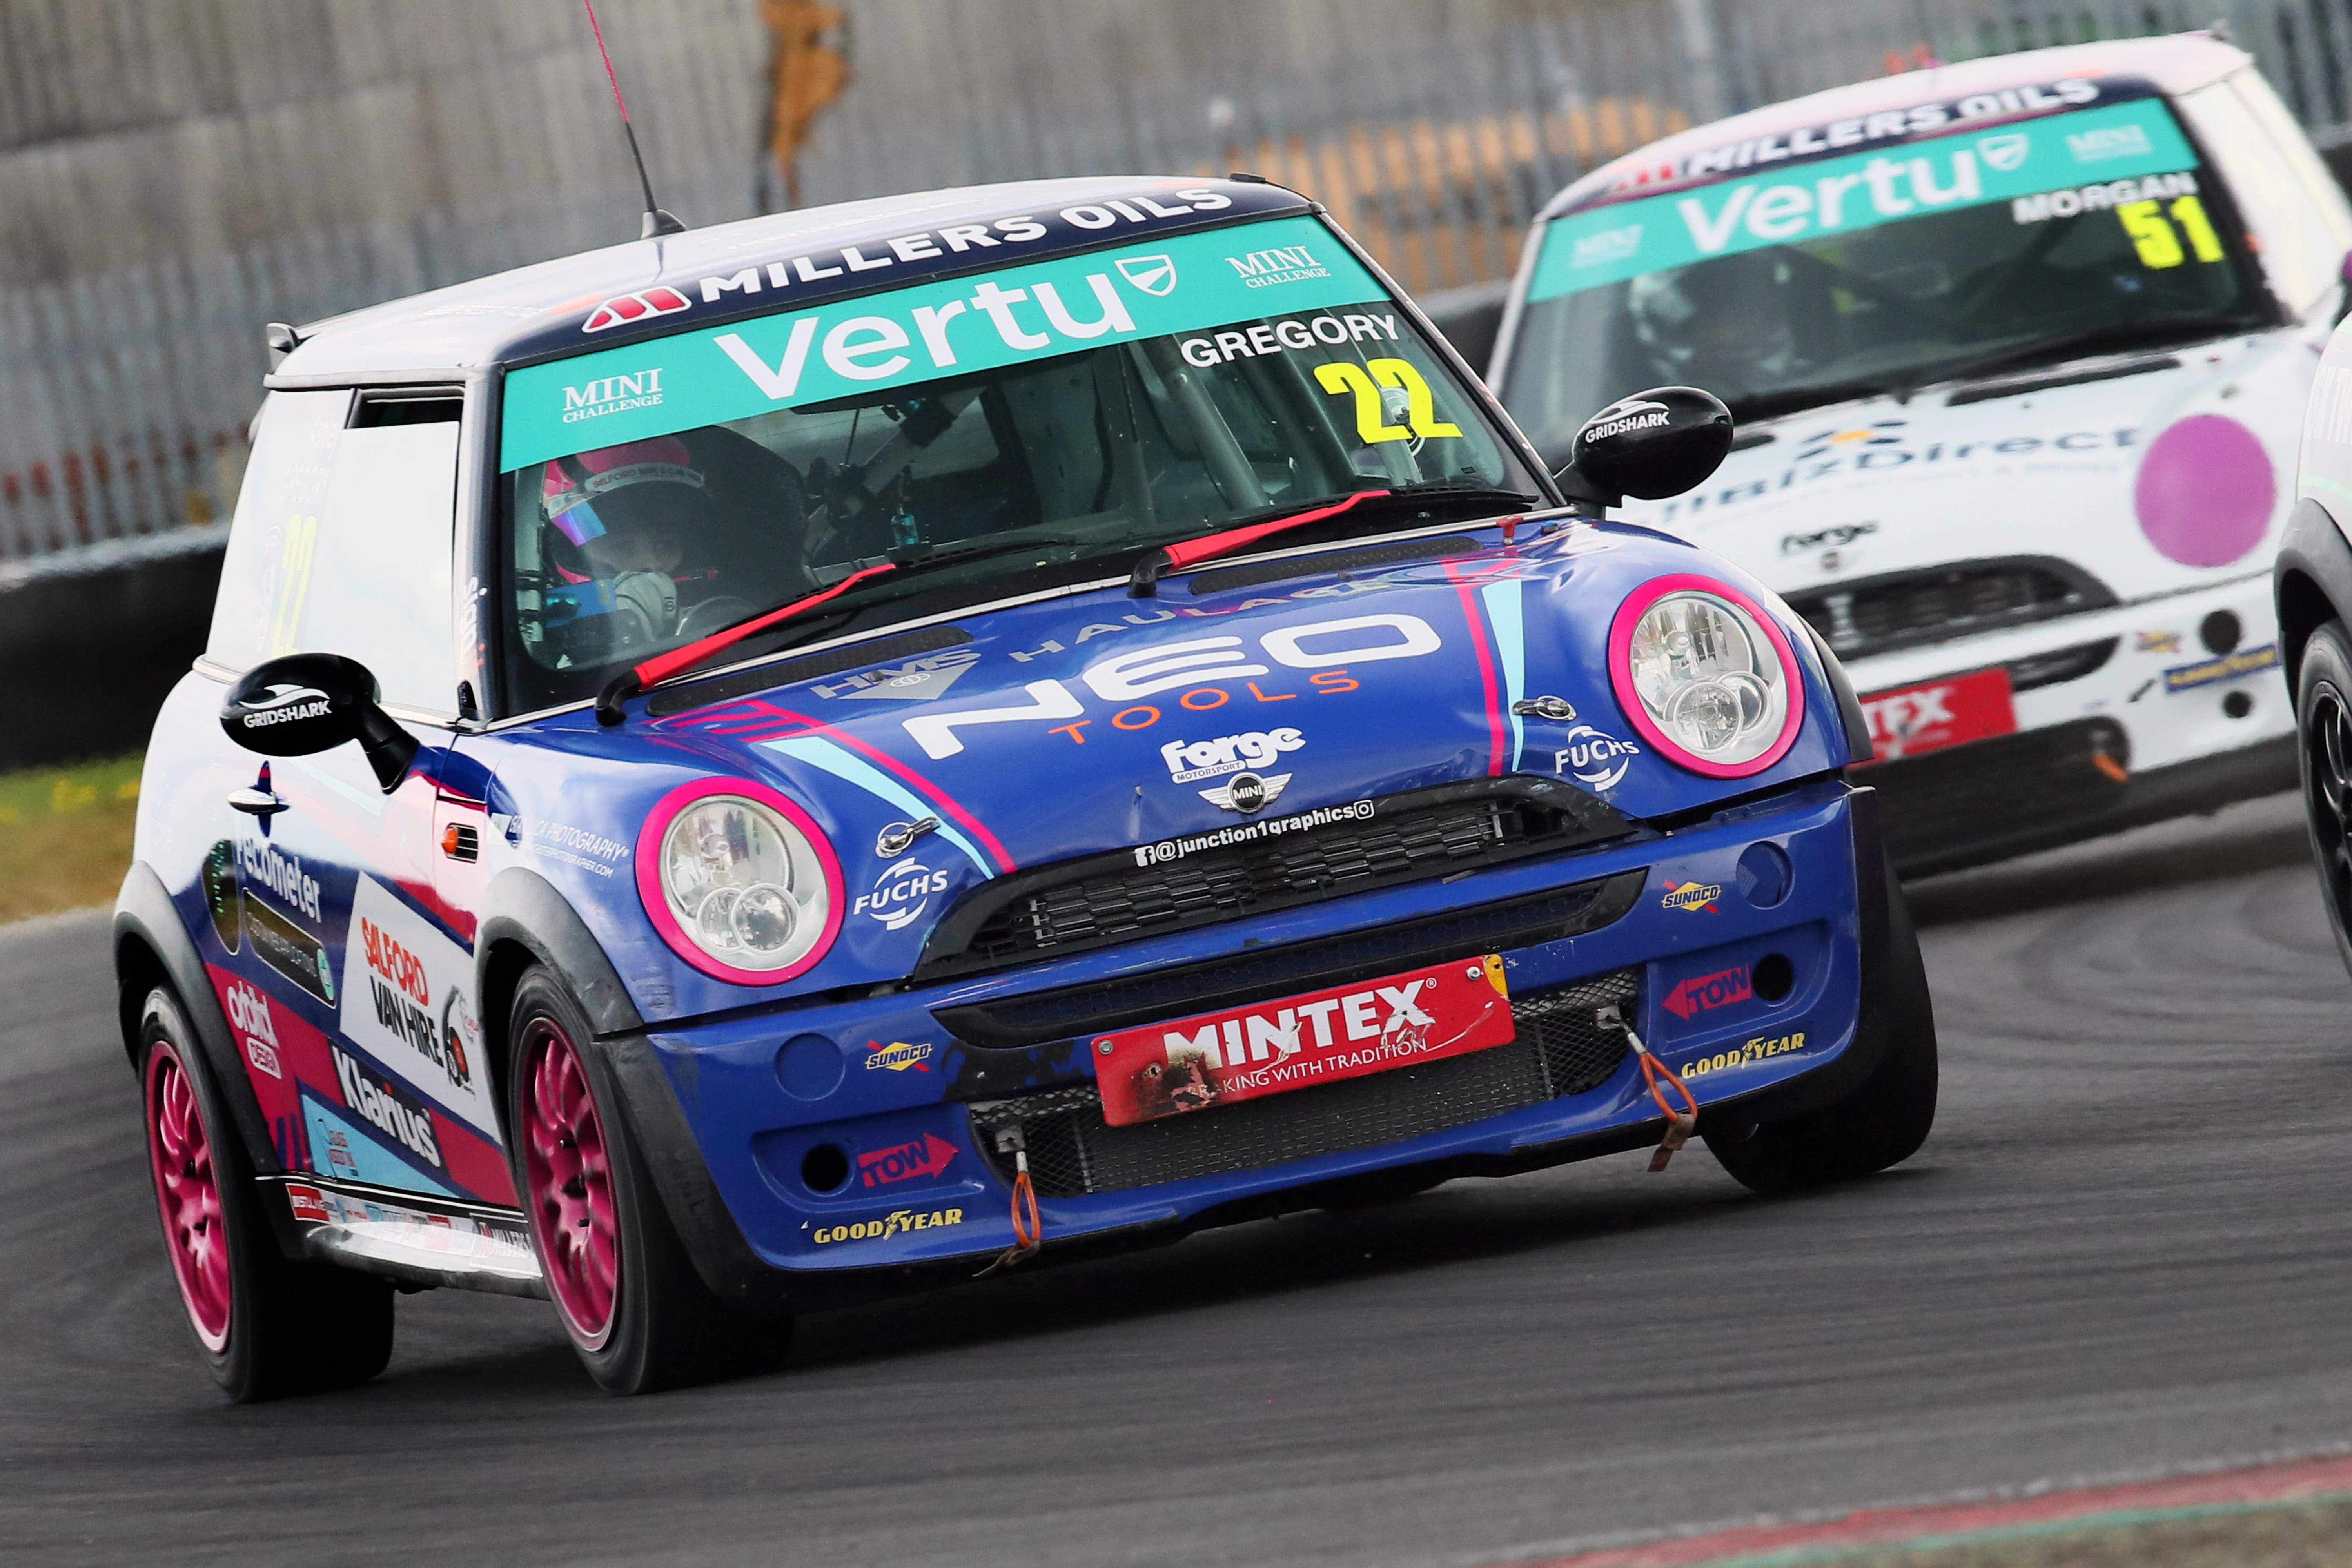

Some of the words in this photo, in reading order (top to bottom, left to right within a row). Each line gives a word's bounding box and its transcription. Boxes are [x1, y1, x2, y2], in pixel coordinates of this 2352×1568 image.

[1680, 149, 1980, 254] Vertu
[2013, 173, 2197, 223] MORGAN
[699, 215, 1048, 303] MILLERS
[1059, 188, 1232, 230] OILS
[2116, 196, 2224, 269] 51
[1225, 245, 1321, 279] MINI
[1245, 267, 1331, 289] CHALLENGE
[712, 272, 1137, 401] Vertu
[1181, 314, 1401, 369] GREGORY
[563, 368, 663, 413] MINI
[563, 394, 663, 424] CHALLENGE
[1313, 358, 1463, 445] 22
[1585, 410, 1670, 443] GRIDSHARK
[810, 648, 982, 700] HMS
[1008, 579, 1390, 662] HAULAGE
[902, 613, 1442, 760] NEO
[1049, 670, 1359, 744] TOOLS
[244, 699, 332, 728] GRIDSHARK
[1861, 686, 1956, 739] TEX
[1177, 762, 1241, 781] MOTORSPORT
[1555, 740, 1640, 774] FUCHS
[1232, 785, 1262, 800] MINI
[853, 870, 948, 915] FUCHS
[1663, 885, 1720, 908] SUNOCO
[362, 917, 429, 1007] SALFORD
[1688, 967, 1749, 1013] TOW
[370, 974, 408, 1045] VAN
[397, 996, 445, 1069] HIRE
[867, 1045, 931, 1070] SUNOCO
[1188, 1071, 1270, 1096] RKING
[1272, 1059, 1323, 1083] WITH
[1326, 1038, 1427, 1070] TRADITION
[1681, 1032, 1805, 1079] GOODYEAR
[332, 1046, 441, 1167] Klarius
[863, 1142, 929, 1187] TOW
[814, 1208, 963, 1244] GOODYEAR
